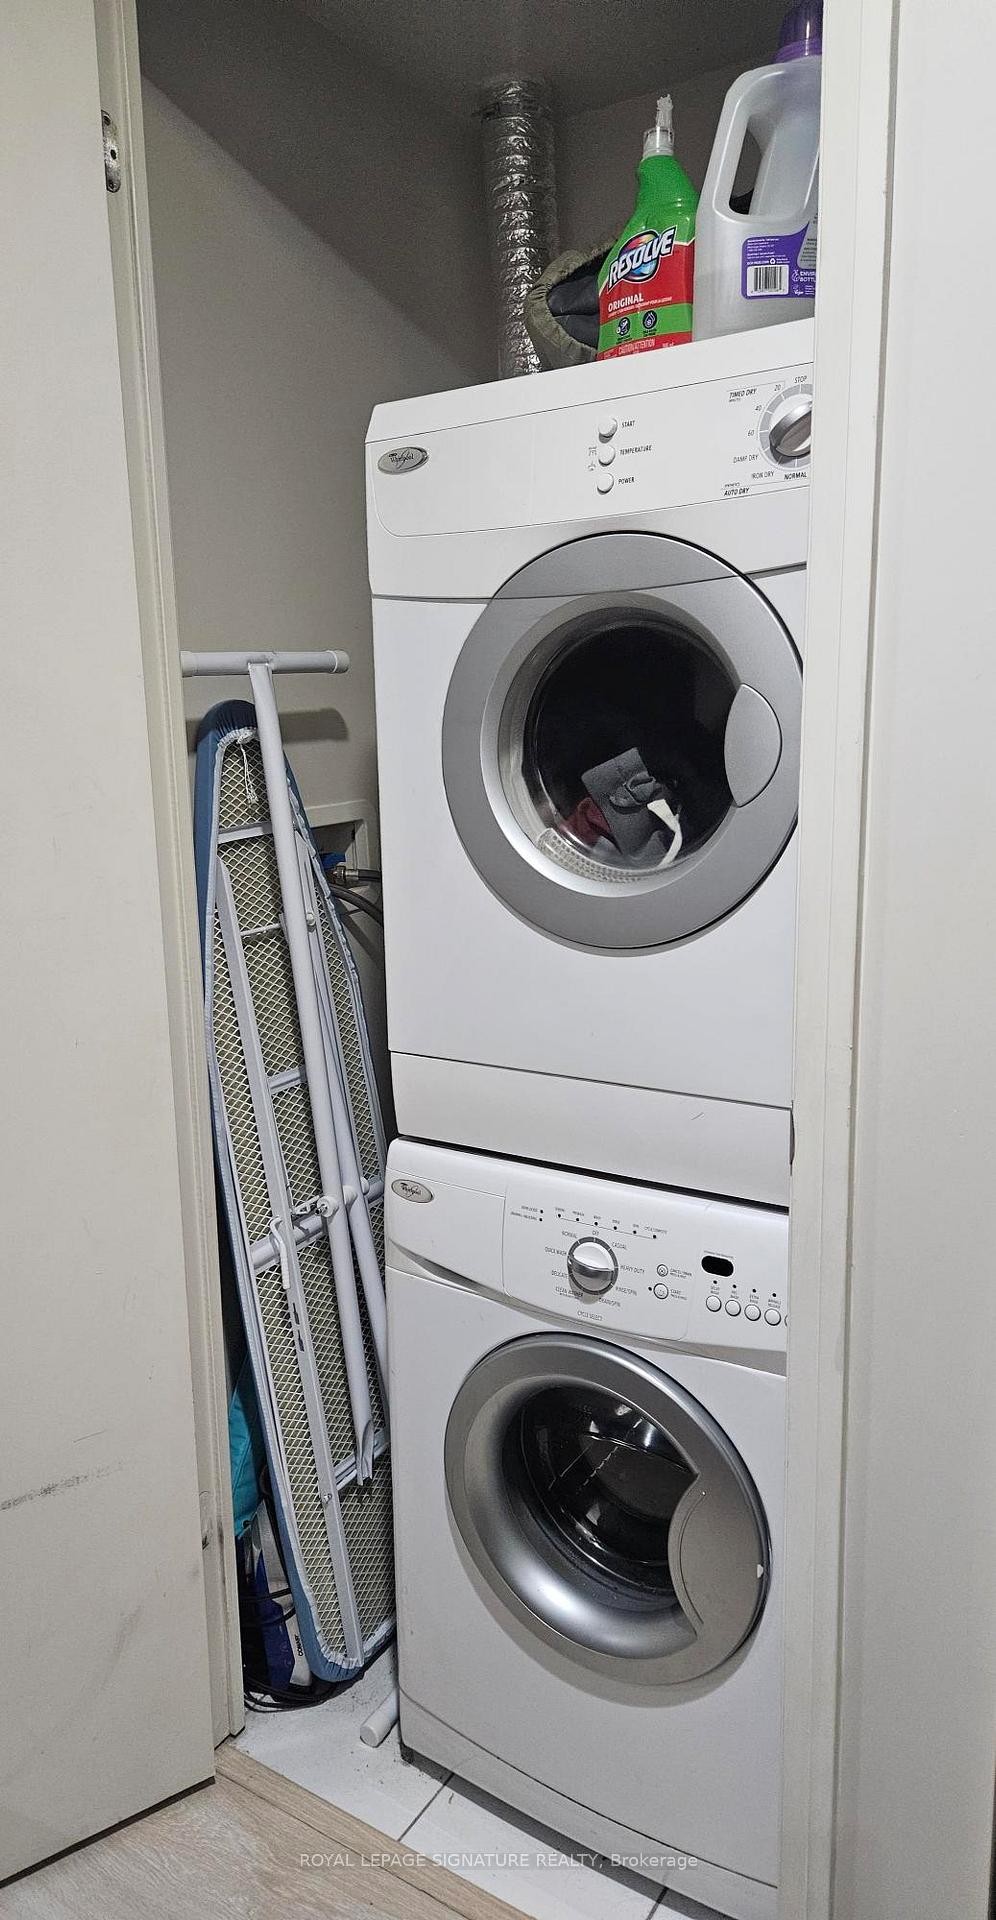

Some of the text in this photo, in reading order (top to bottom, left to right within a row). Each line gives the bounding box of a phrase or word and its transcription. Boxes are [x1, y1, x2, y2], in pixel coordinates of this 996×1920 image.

[608, 227, 677, 289] RESOLVE
[608, 293, 644, 313] ORIGINAL
[794, 375, 807, 383] STOP
[729, 387, 757, 399] TIMED DRY
[622, 420, 636, 428] START
[619, 444, 653, 456] TEMPERATURE
[748, 454, 759, 463] DRY
[764, 470, 775, 478] DRY
[784, 472, 807, 481] NORMAL
[618, 476, 635, 485] POWER
[724, 487, 750, 497] AUTO DRY
